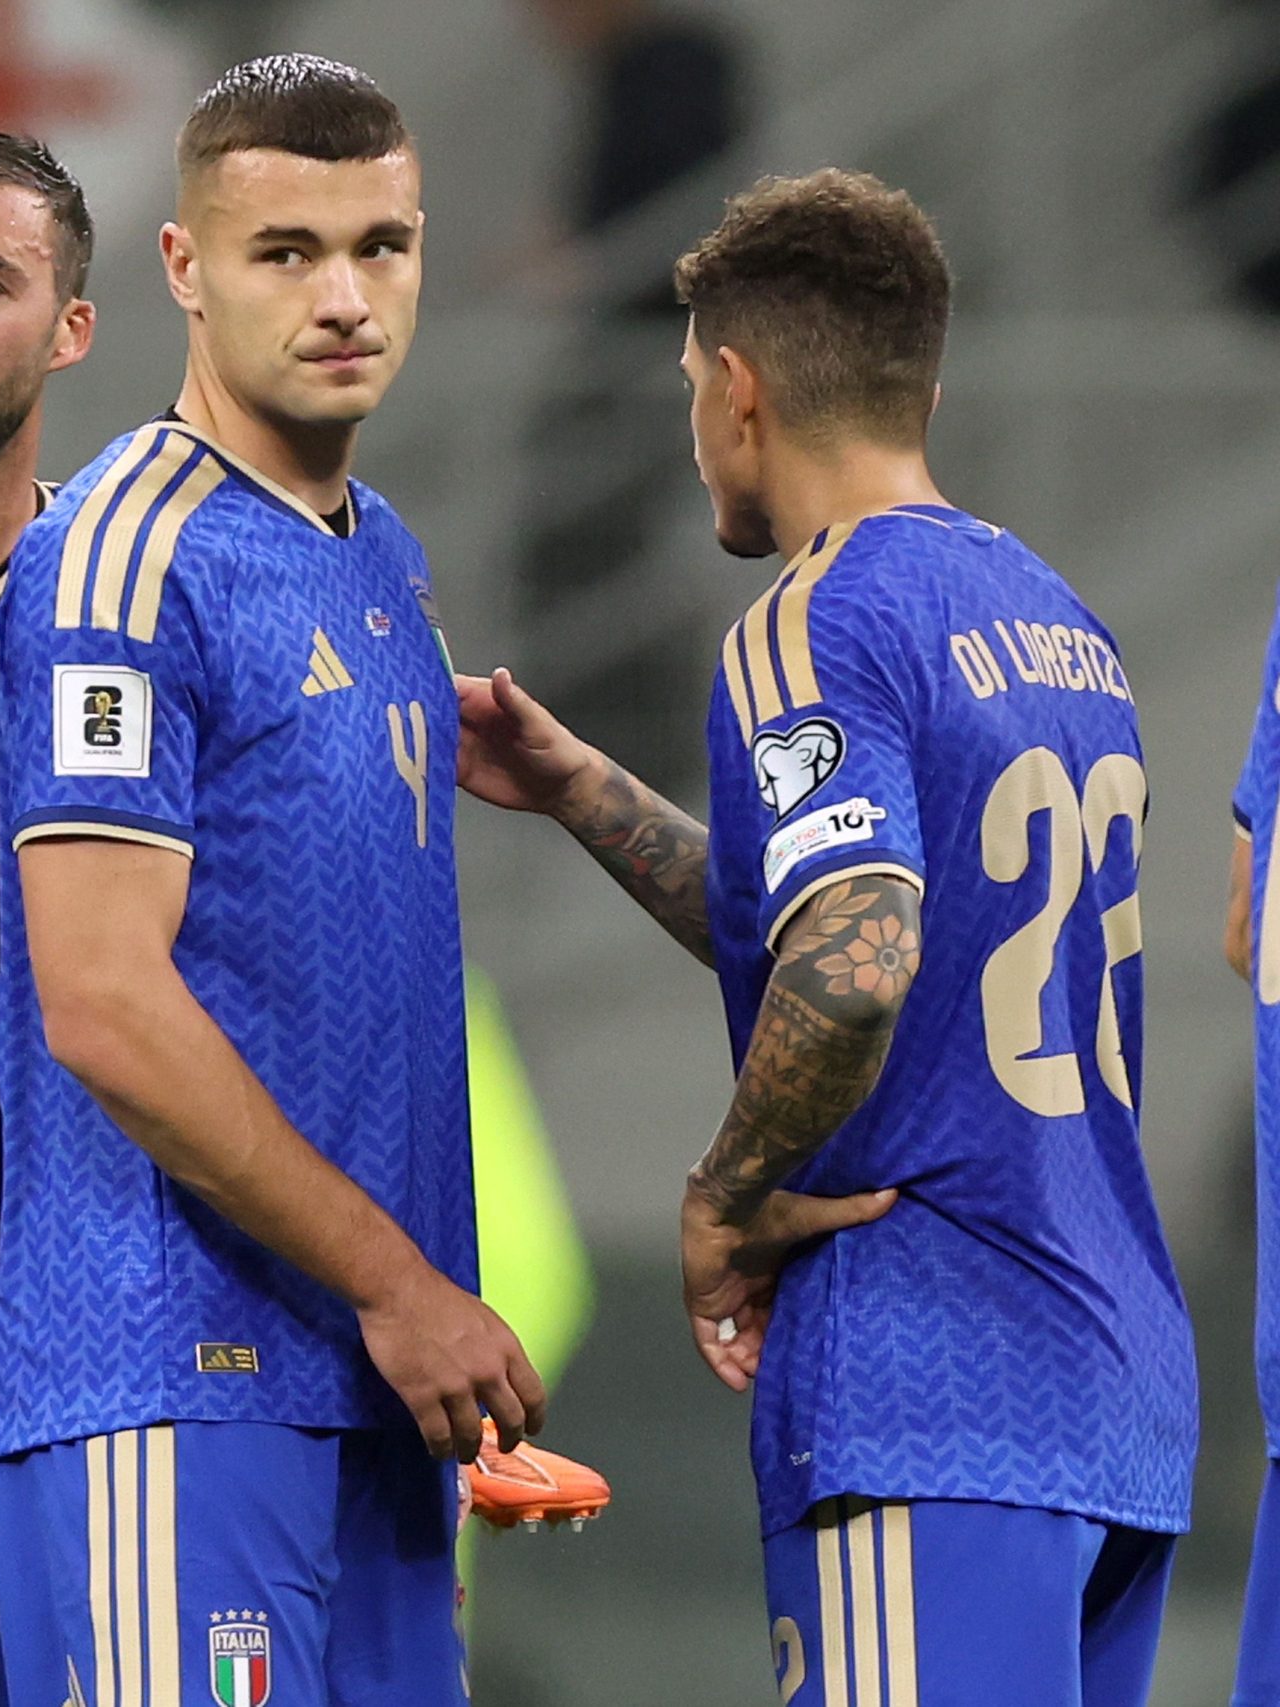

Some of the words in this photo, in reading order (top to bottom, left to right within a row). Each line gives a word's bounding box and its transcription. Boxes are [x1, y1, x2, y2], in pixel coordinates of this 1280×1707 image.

[949, 628, 1009, 700] DI
[993, 618, 1135, 706] LORENZ
[387, 700, 427, 849] 4
[214, 1631, 265, 1651] ITALIA
